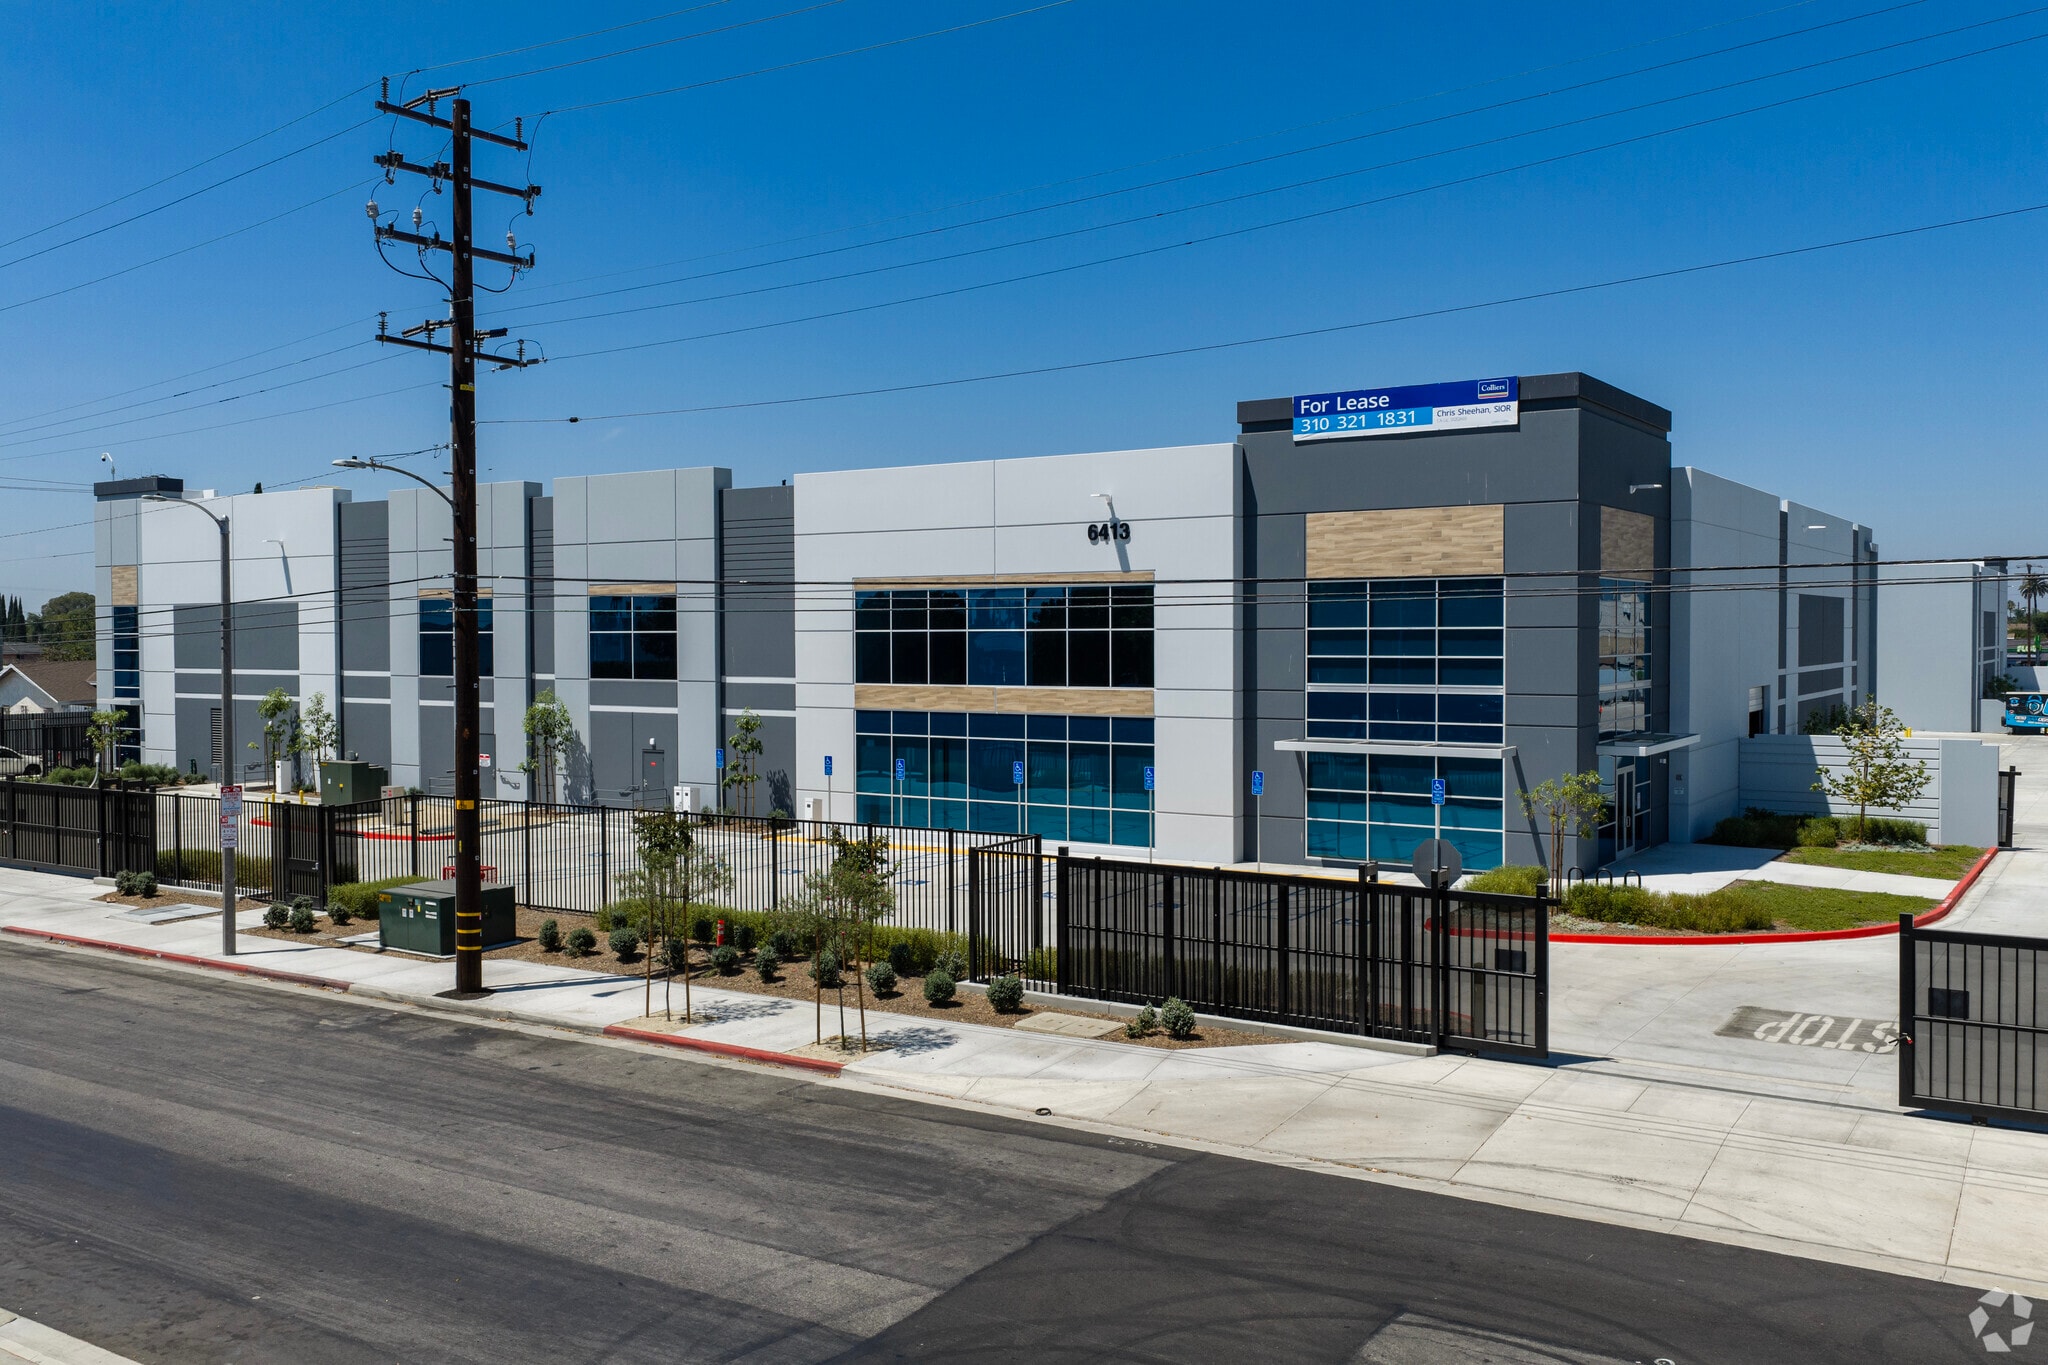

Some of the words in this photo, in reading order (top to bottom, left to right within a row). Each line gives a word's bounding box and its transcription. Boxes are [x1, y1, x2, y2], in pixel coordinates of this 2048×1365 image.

[1481, 384, 1506, 392] Colliers
[1300, 400, 1330, 415] For
[1336, 395, 1390, 412] Lease
[1436, 409, 1456, 418] Chris
[1457, 406, 1492, 416] Sheehan,
[1494, 404, 1512, 413] SIOR
[1300, 417, 1330, 432] 310
[1337, 414, 1366, 429] 321
[1377, 410, 1416, 426] 1831
[1087, 522, 1131, 541] 6413
[1754, 1013, 1899, 1054] STOP
